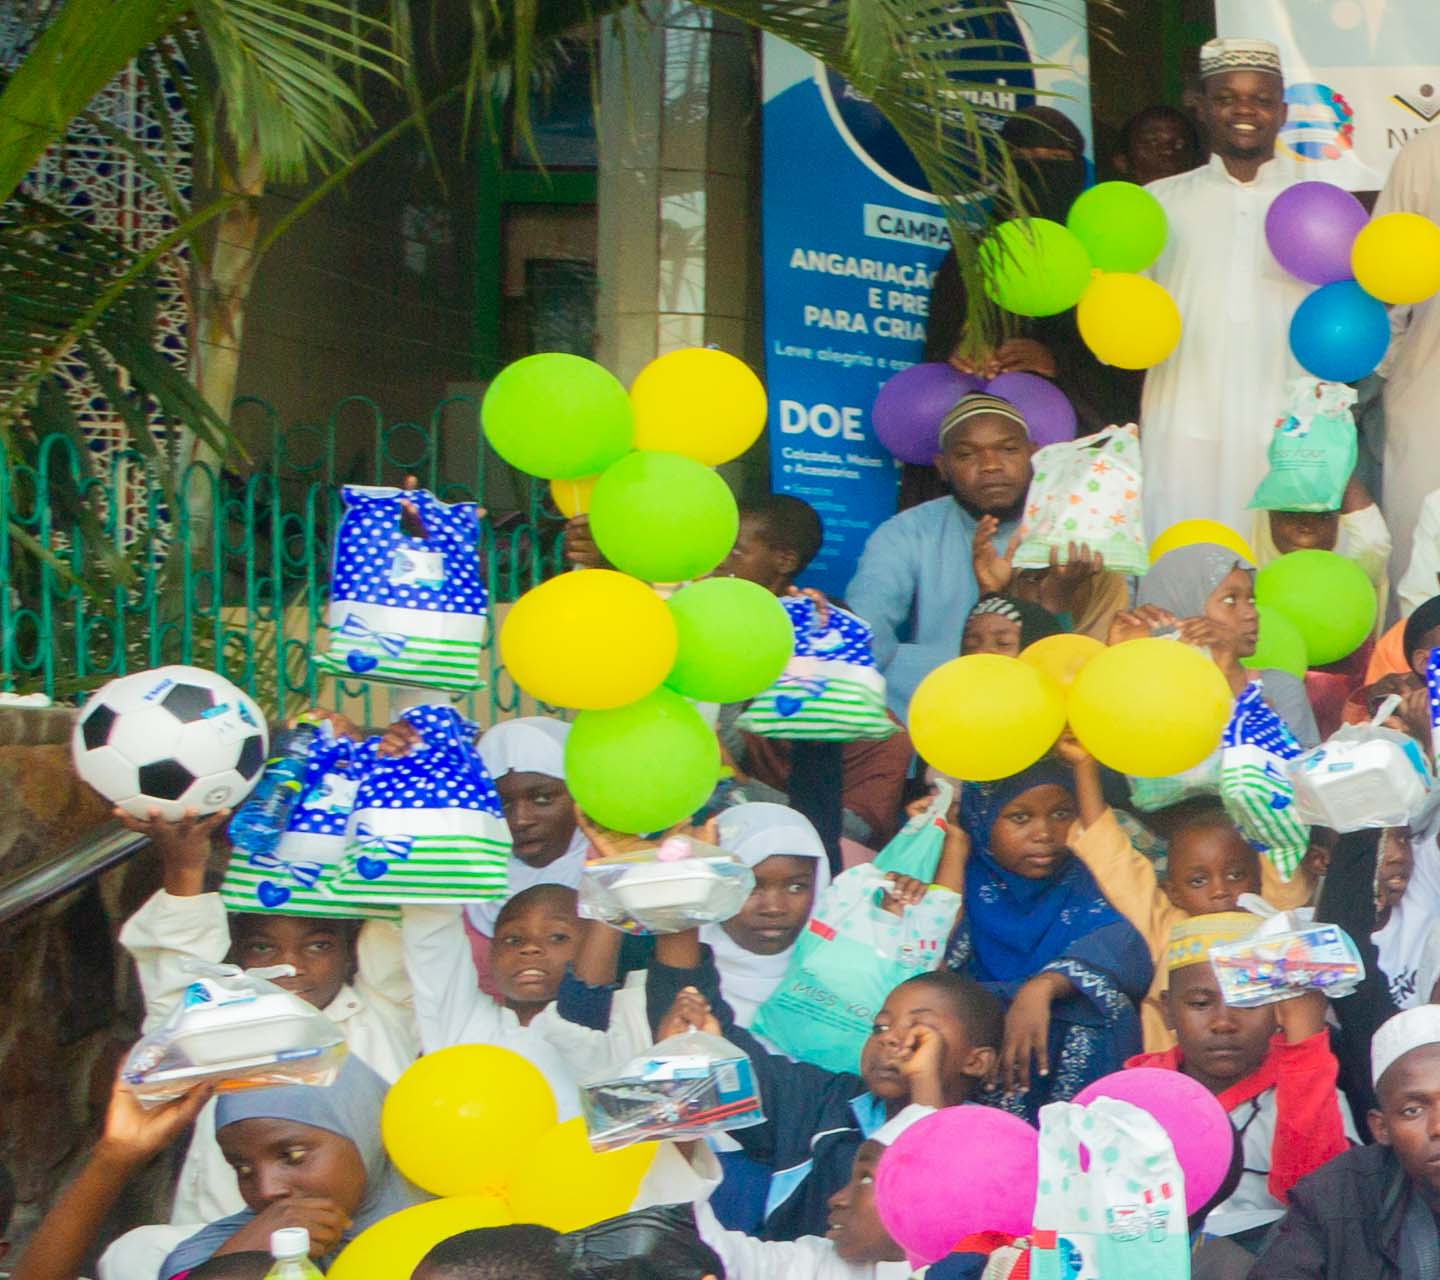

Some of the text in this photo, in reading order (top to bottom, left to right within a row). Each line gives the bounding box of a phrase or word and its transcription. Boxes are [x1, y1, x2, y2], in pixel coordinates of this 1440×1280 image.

[876, 214, 952, 247] CAMPA
[868, 287, 883, 309] E
[803, 304, 869, 335] PARA
[779, 399, 866, 441] DOE
